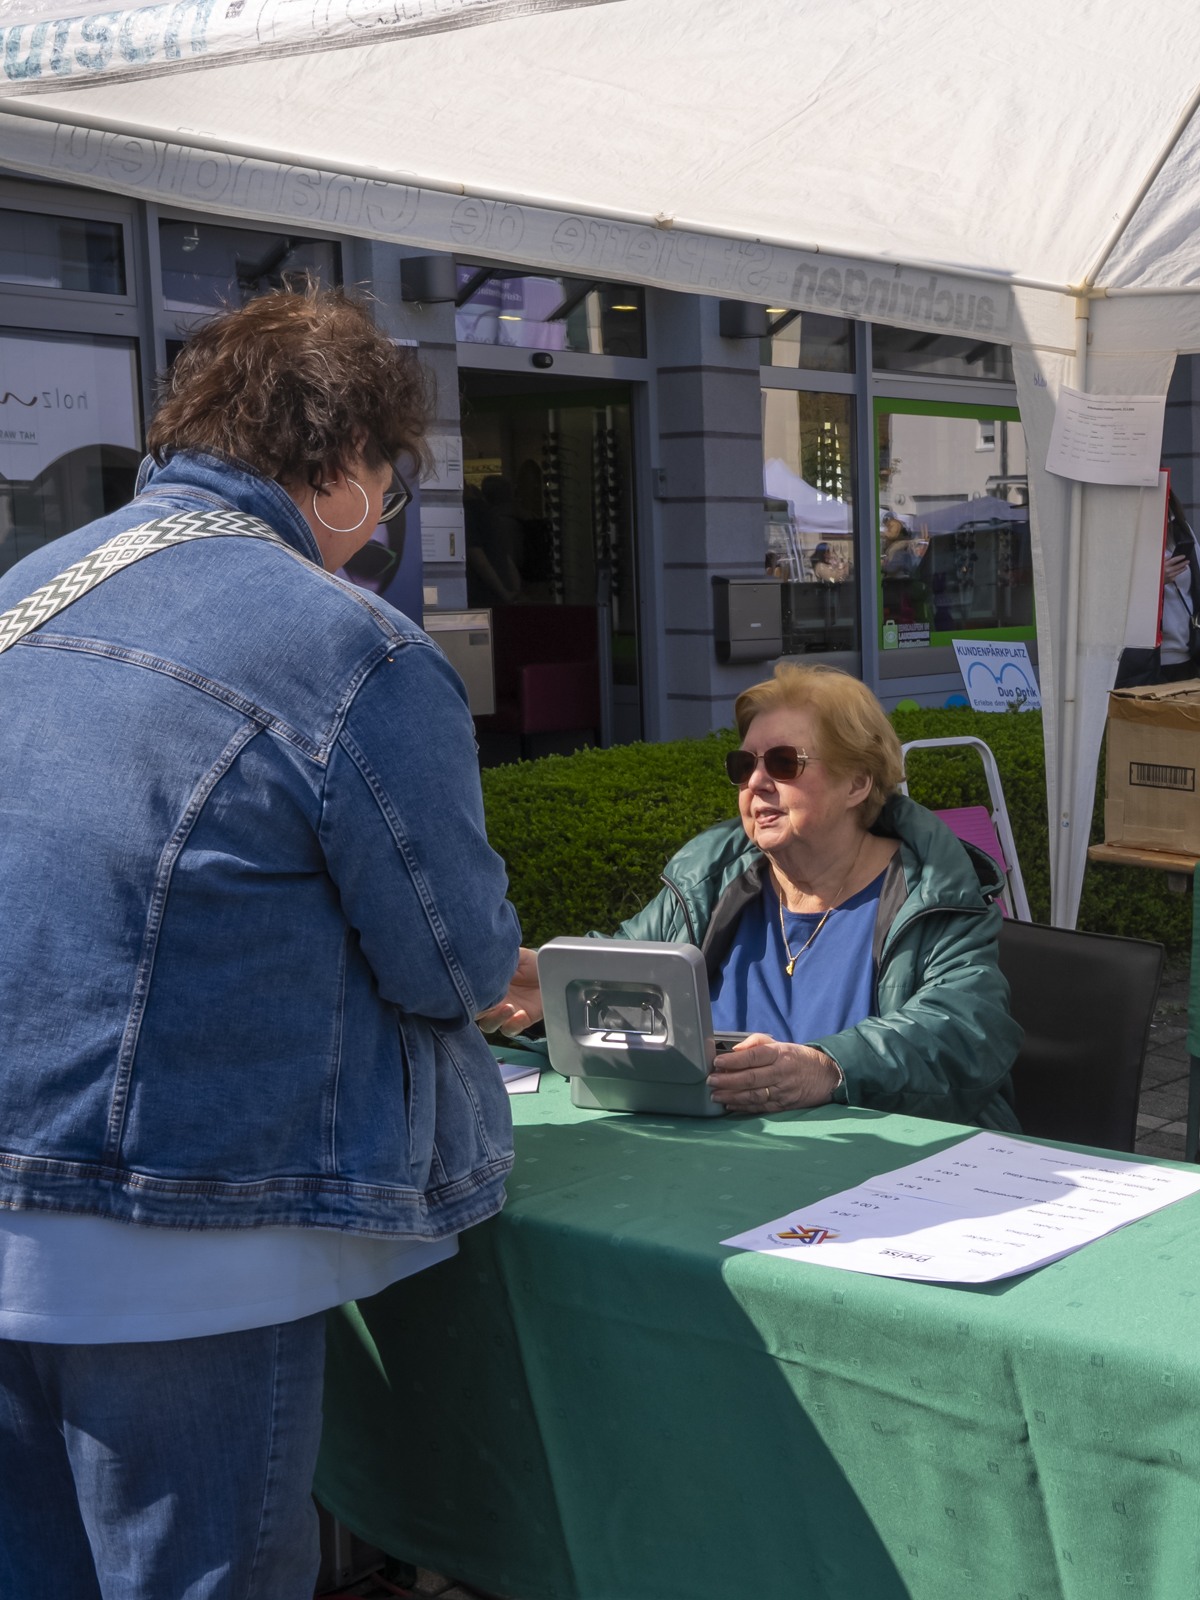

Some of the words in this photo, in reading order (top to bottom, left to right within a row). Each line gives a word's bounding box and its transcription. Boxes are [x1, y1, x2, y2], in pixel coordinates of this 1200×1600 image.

[956, 646, 1027, 658] KUNDENPARKPLATZ
[997, 687, 1014, 697] Duo
[878, 1249, 931, 1263] Preise
